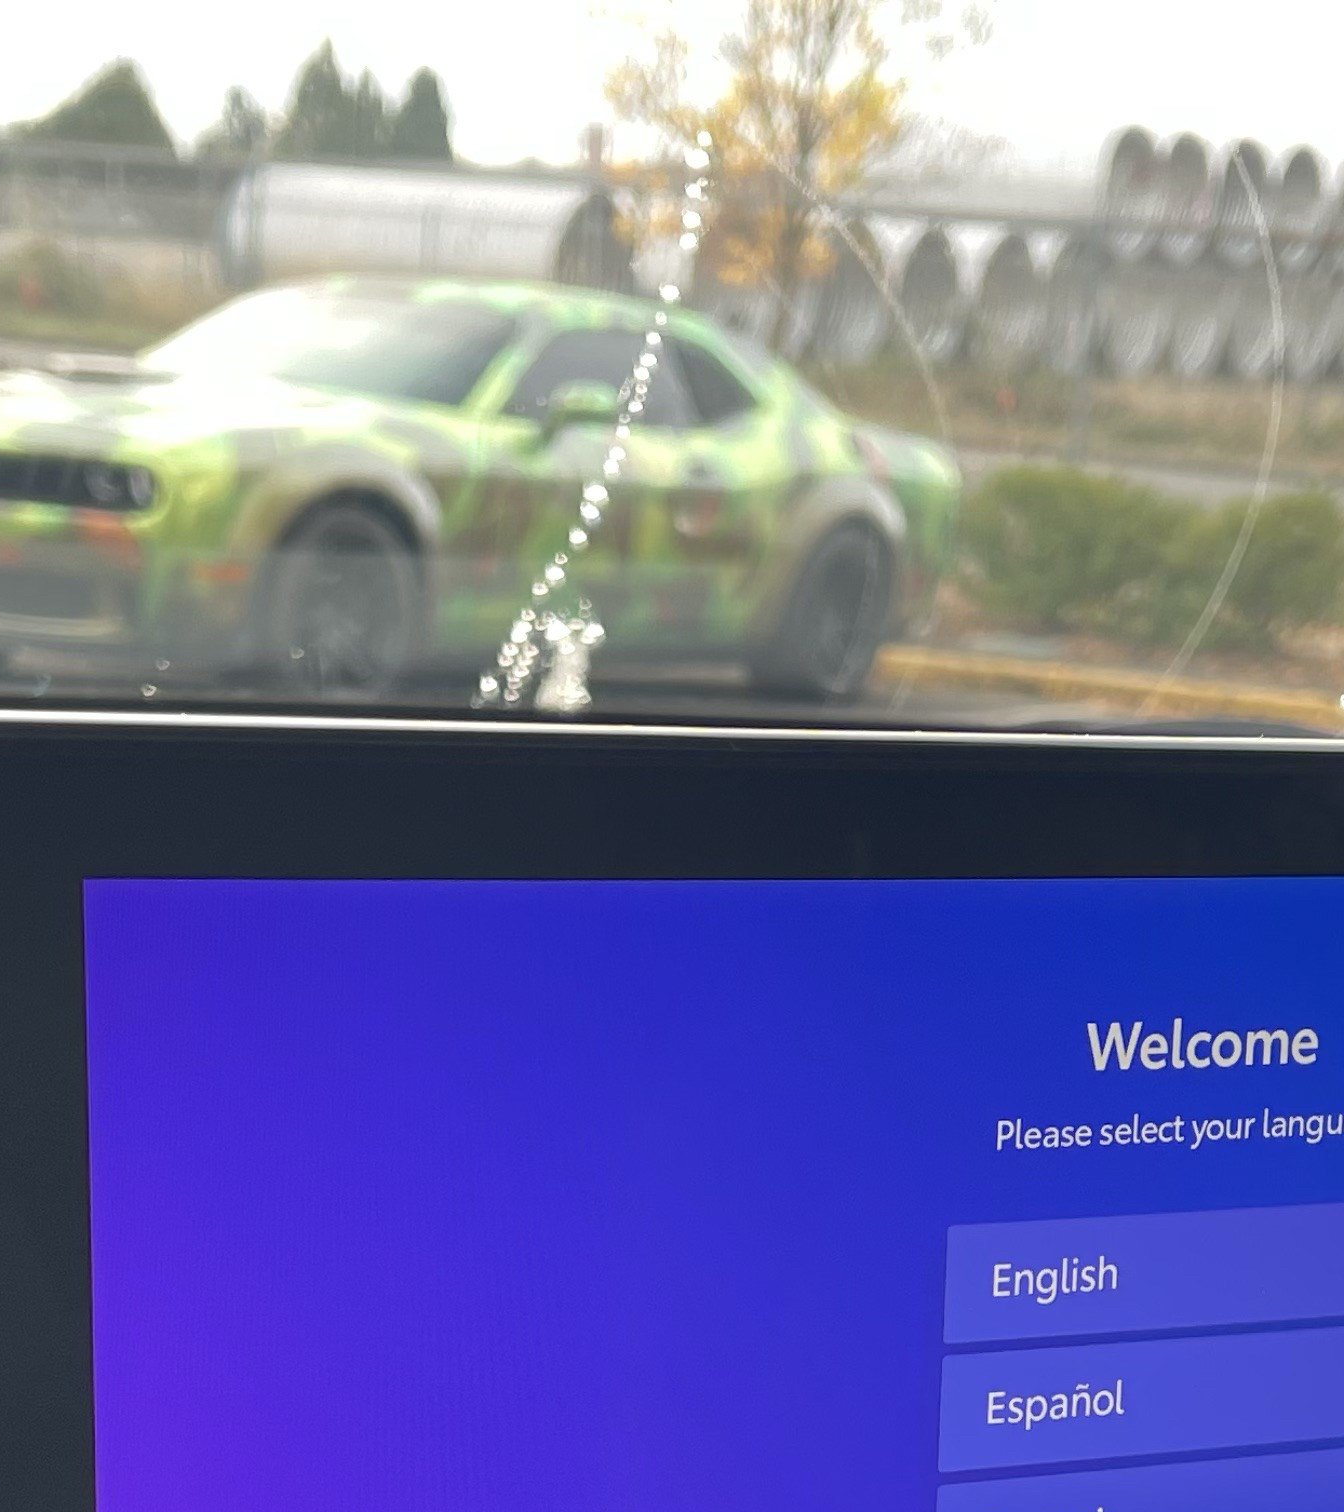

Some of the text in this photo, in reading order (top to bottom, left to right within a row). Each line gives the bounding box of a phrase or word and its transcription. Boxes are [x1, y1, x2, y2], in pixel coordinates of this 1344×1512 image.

[1086, 1018, 1320, 1072] Welcome
[996, 1118, 1093, 1151] Please
[1099, 1114, 1185, 1146] select
[1190, 1117, 1256, 1151] your
[992, 1256, 1119, 1304] English
[986, 1379, 1125, 1430] Español
